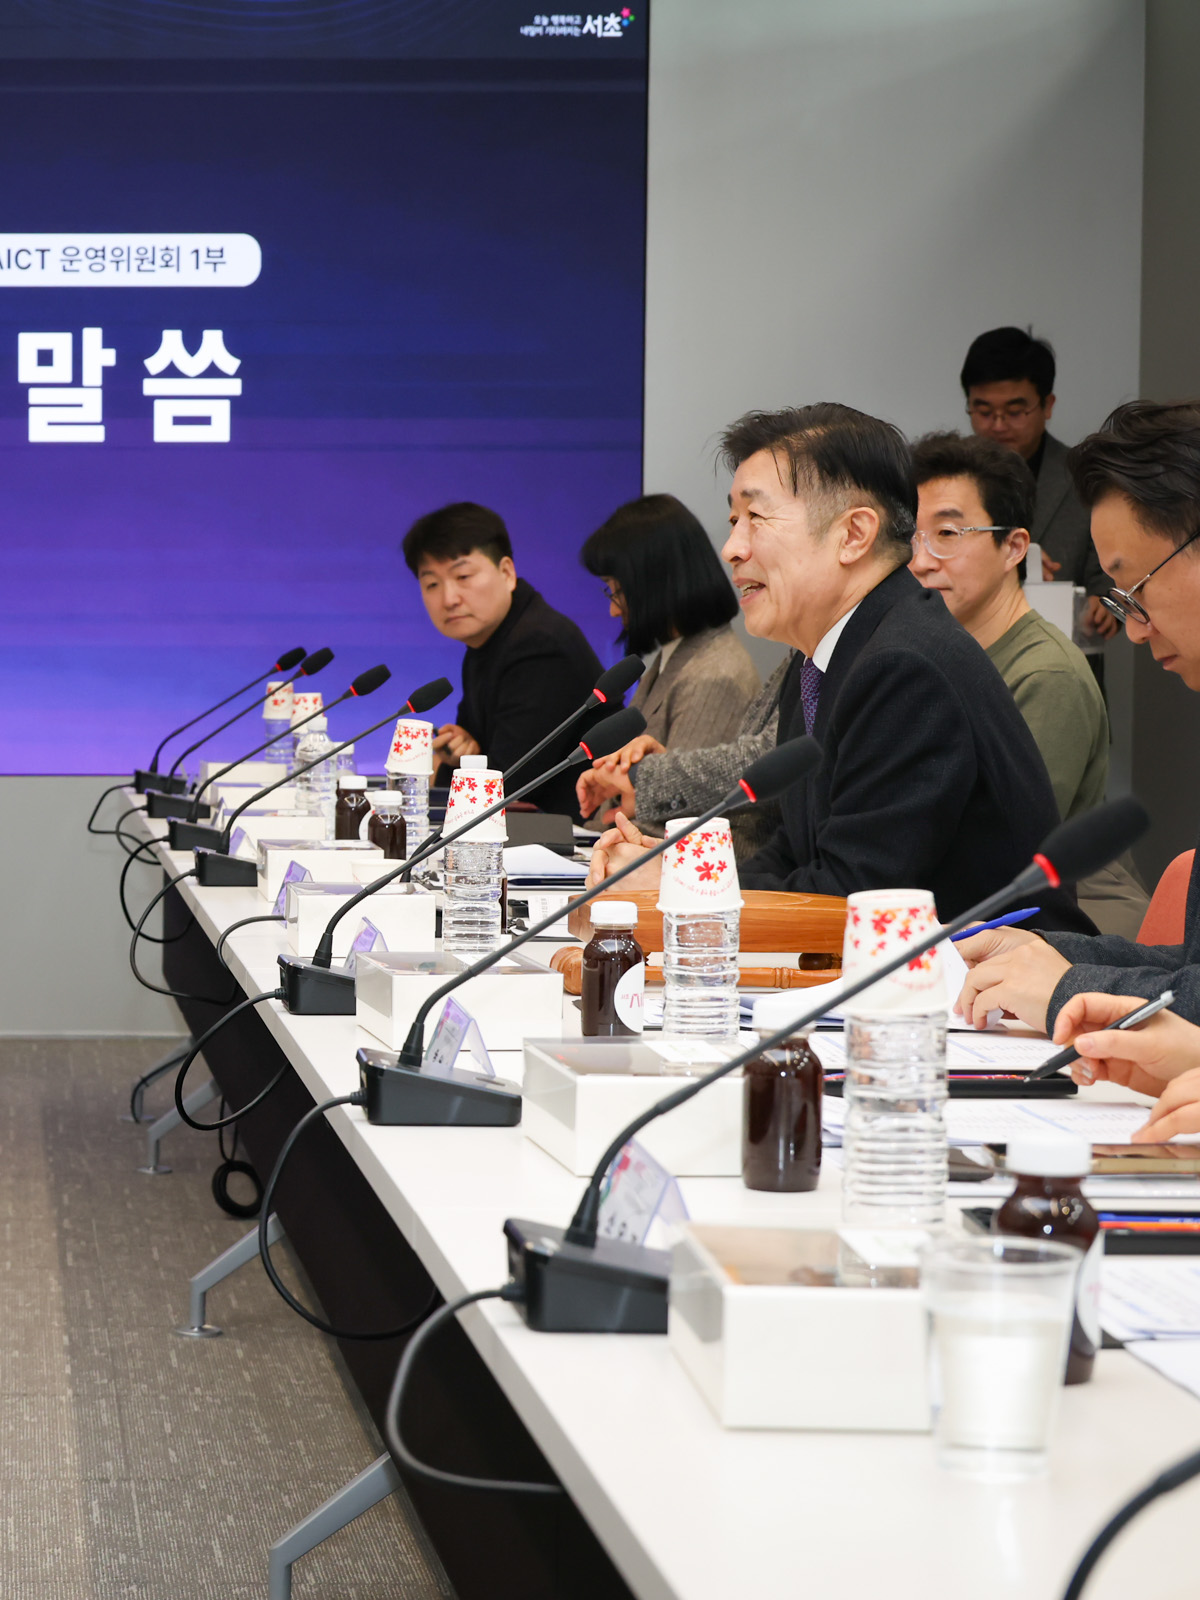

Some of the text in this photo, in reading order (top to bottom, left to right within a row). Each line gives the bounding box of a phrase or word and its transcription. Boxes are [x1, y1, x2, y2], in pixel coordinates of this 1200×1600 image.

[582, 13, 624, 38] 서초
[59, 246, 180, 273] 운영위원회
[191, 247, 227, 273] 1부
